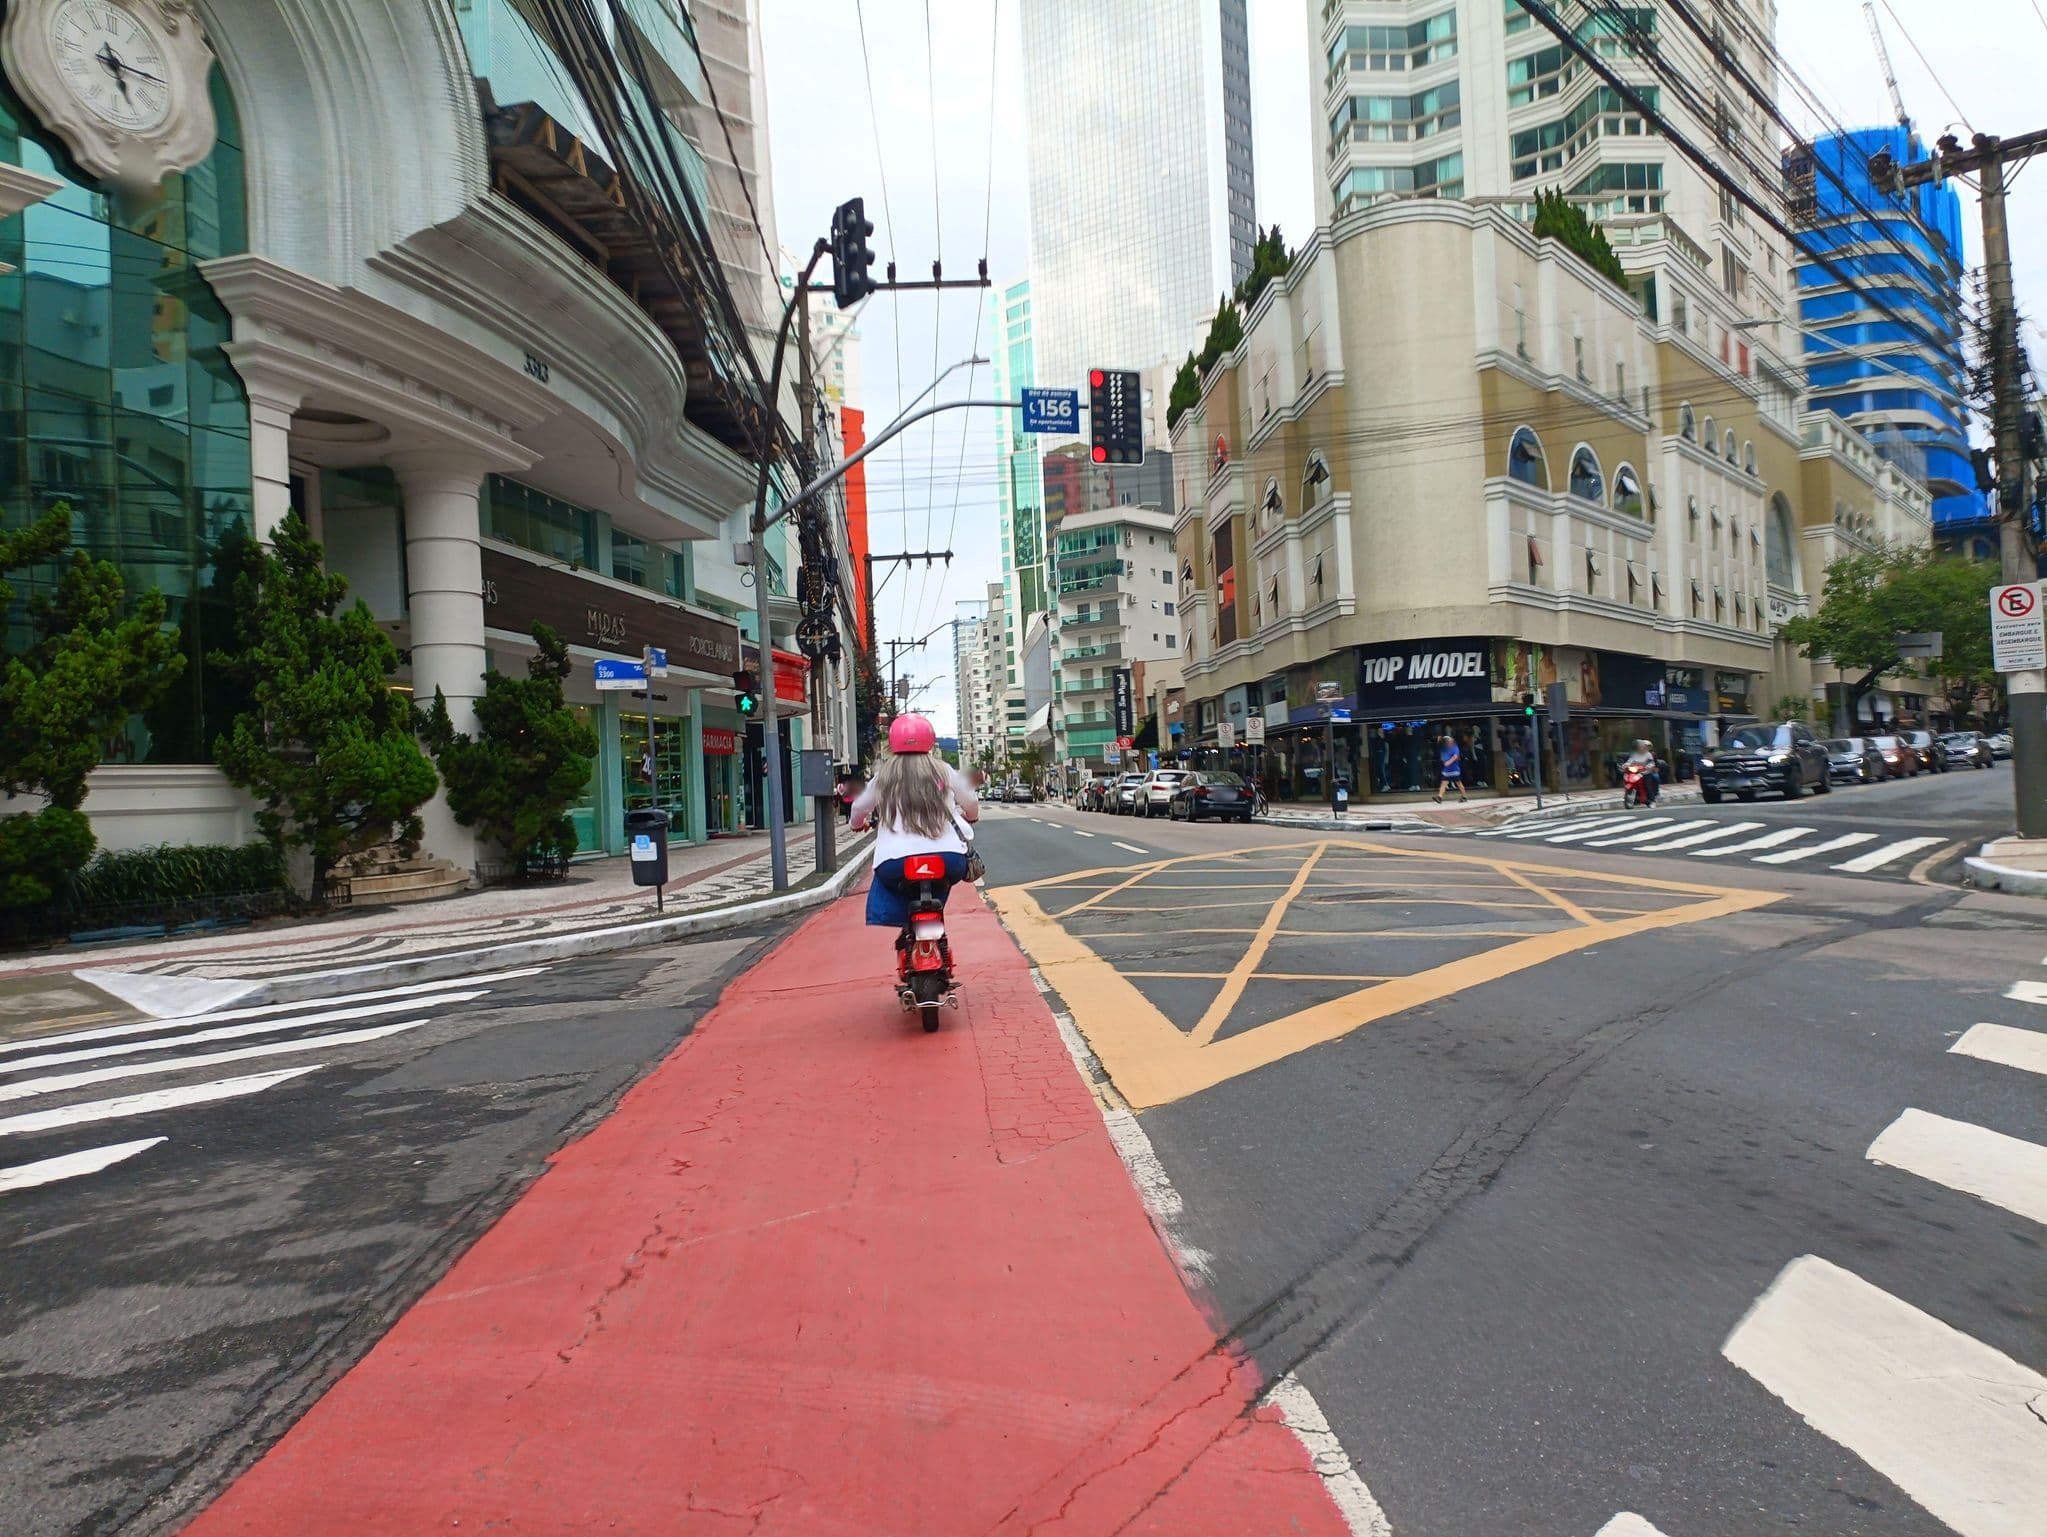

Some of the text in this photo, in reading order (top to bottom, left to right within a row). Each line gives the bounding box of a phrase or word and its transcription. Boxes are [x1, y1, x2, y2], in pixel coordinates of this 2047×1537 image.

[1037, 399, 1072, 418] 156
[587, 608, 626, 637] MIDAS
[688, 636, 733, 662] PORCELANAS
[1363, 652, 1486, 684] TOP MODEL
